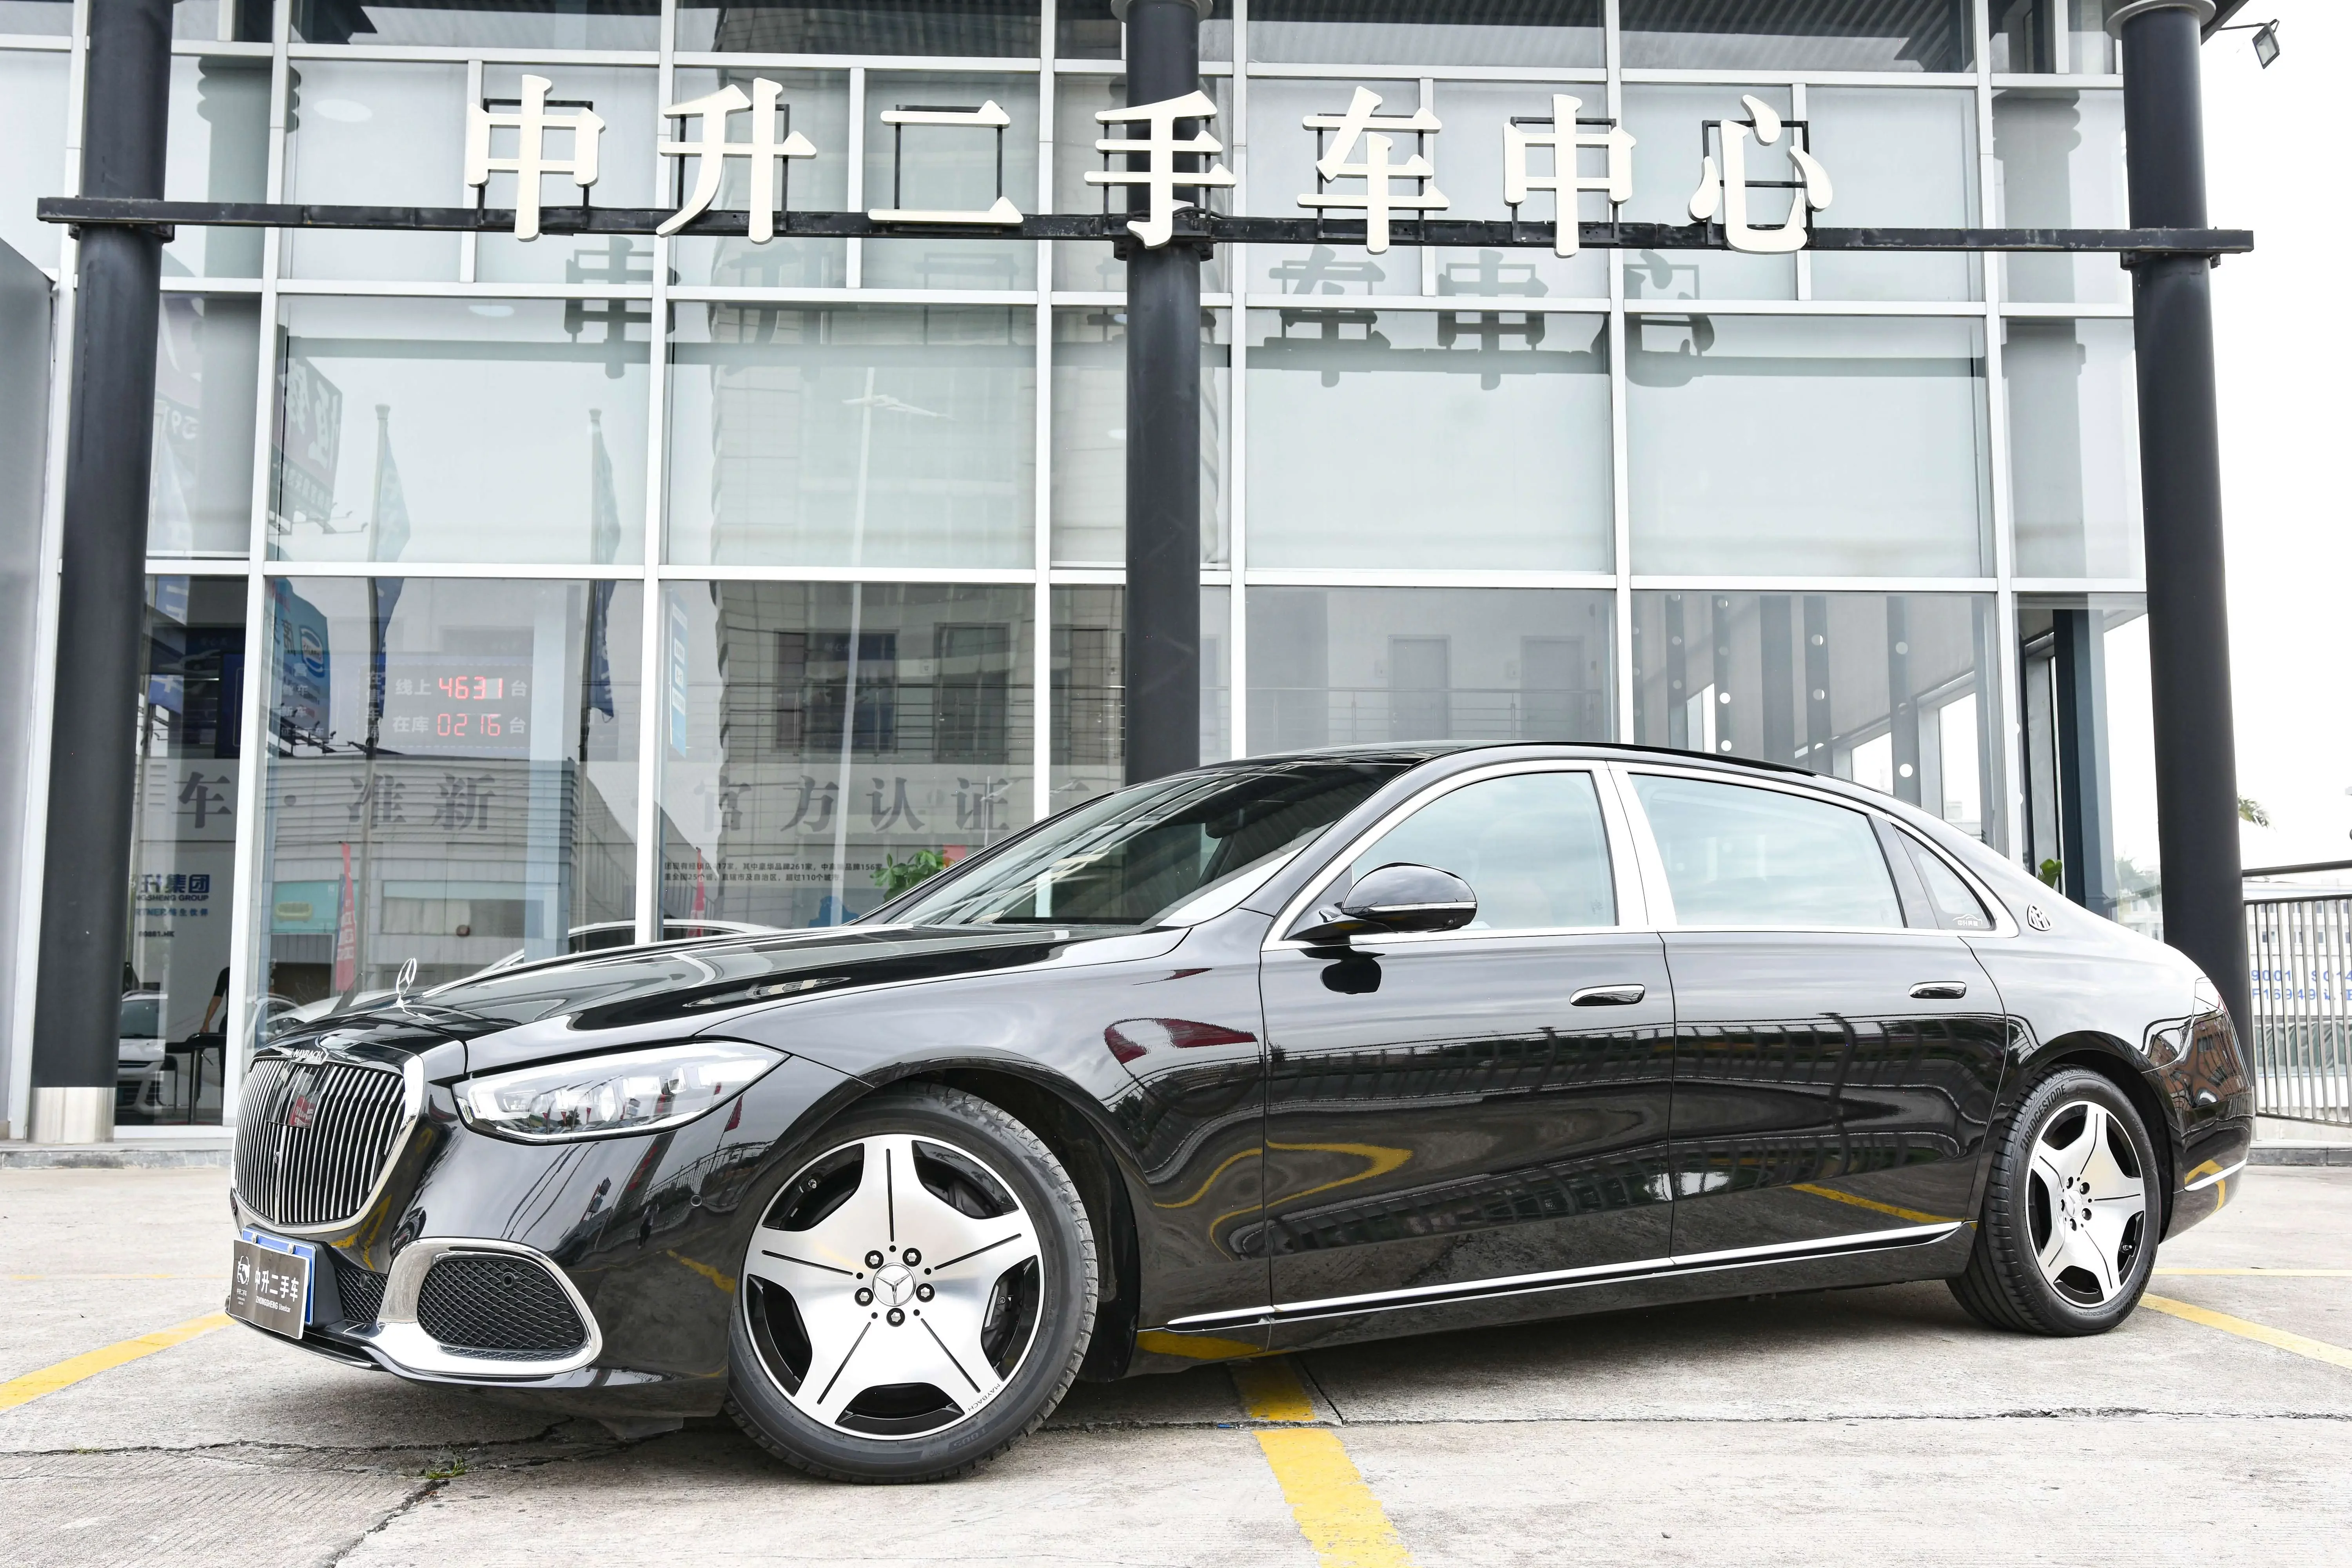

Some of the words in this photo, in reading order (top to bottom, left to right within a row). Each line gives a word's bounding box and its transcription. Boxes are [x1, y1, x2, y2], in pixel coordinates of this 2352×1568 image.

[466, 74, 1834, 257] 中升二手车中心
[395, 679, 432, 696] 线上
[438, 676, 503, 699] 4631
[510, 680, 528, 697] 台
[392, 716, 430, 733] 在库
[437, 713, 501, 736] 0216
[509, 717, 526, 734] 台
[293, 1049, 323, 1060] MAYBACH
[2020, 1083, 2066, 1154] BRIDGESTONE
[254, 1267, 299, 1302] 中升二手车
[256, 1295, 278, 1310] ZHONGSHENG
[968, 1383, 1000, 1412] MAYBACH
